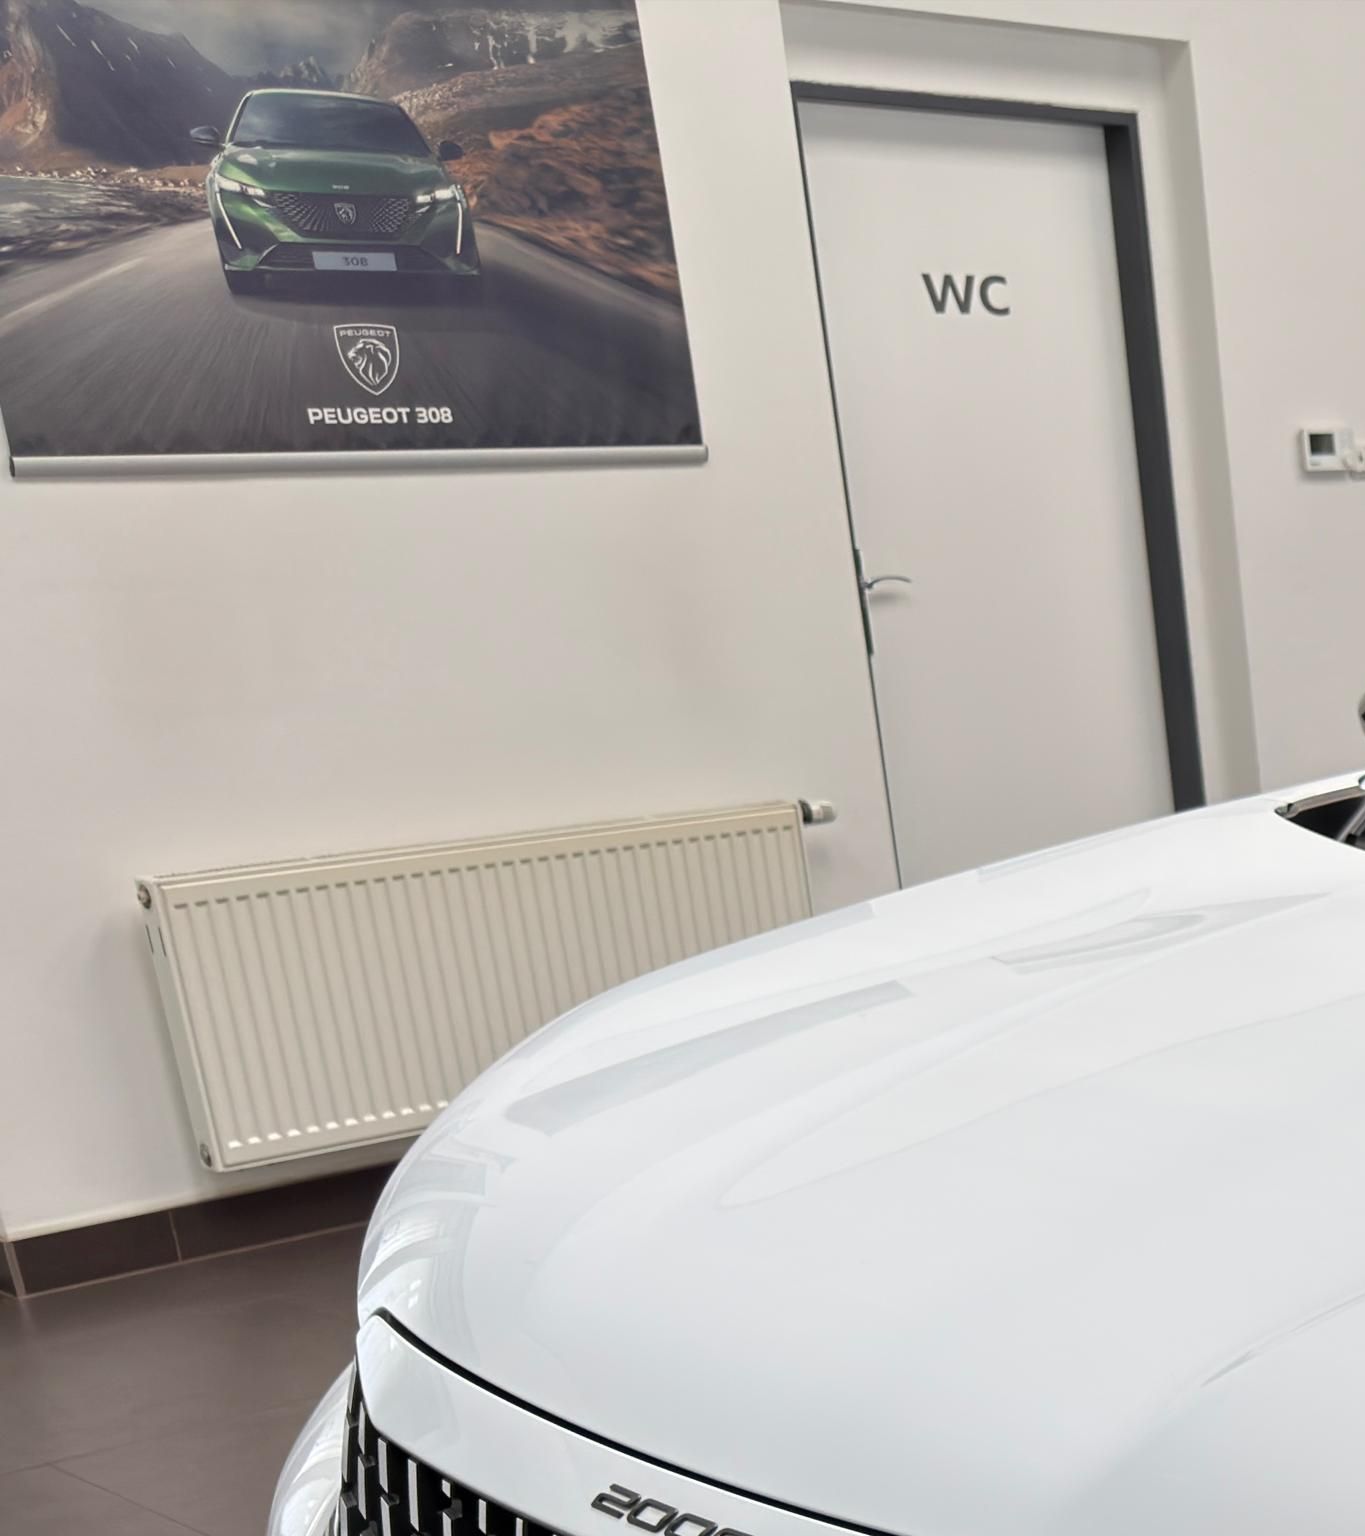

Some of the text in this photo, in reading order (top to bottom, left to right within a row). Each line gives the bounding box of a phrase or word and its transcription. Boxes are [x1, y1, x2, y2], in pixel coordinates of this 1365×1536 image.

[921, 272, 1011, 316] WC
[339, 328, 392, 337] PEUGEOT
[306, 406, 454, 424] PEUGEOT 308
